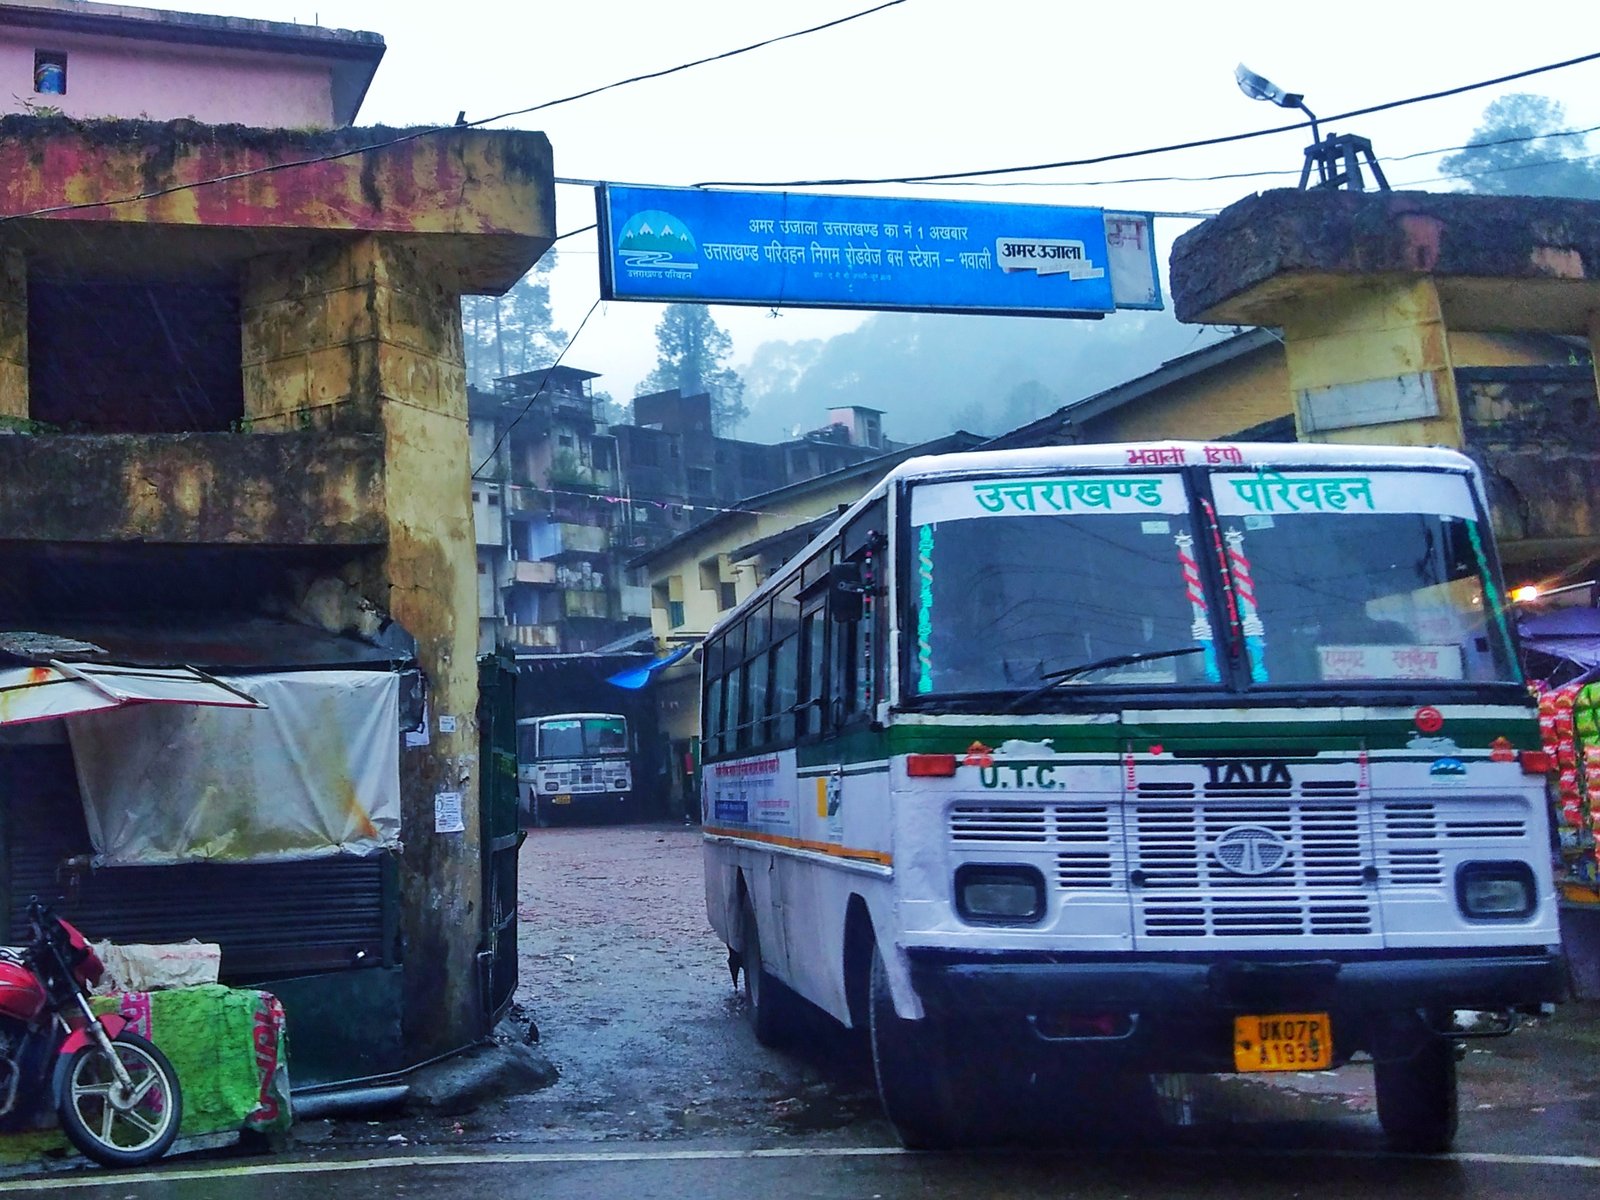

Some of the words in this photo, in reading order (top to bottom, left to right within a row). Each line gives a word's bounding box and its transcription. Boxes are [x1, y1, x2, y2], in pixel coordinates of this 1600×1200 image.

[749, 219, 774, 234] अमर
[779, 220, 818, 235] उजाला
[823, 221, 878, 237] उत्तराखण्ड
[883, 223, 899, 238] का
[918, 226, 923, 239] 1
[929, 226, 968, 240] अखबार
[703, 243, 759, 261] उत्तराखण्ड
[763, 240, 805, 264] परिवहन
[810, 241, 840, 264] निगम
[844, 242, 882, 266] रोडवेज
[886, 249, 903, 267] बस
[908, 244, 941, 268] स्टेशन
[959, 247, 991, 270] भवाली
[1002, 243, 1036, 258] अमर
[1037, 244, 1081, 260] उजाला
[973, 478, 1163, 513] उत्तराखण्ड
[1229, 464, 1375, 511] परिवहन
[979, 762, 1067, 789] U.T.C.
[1203, 762, 1293, 784] TATA
